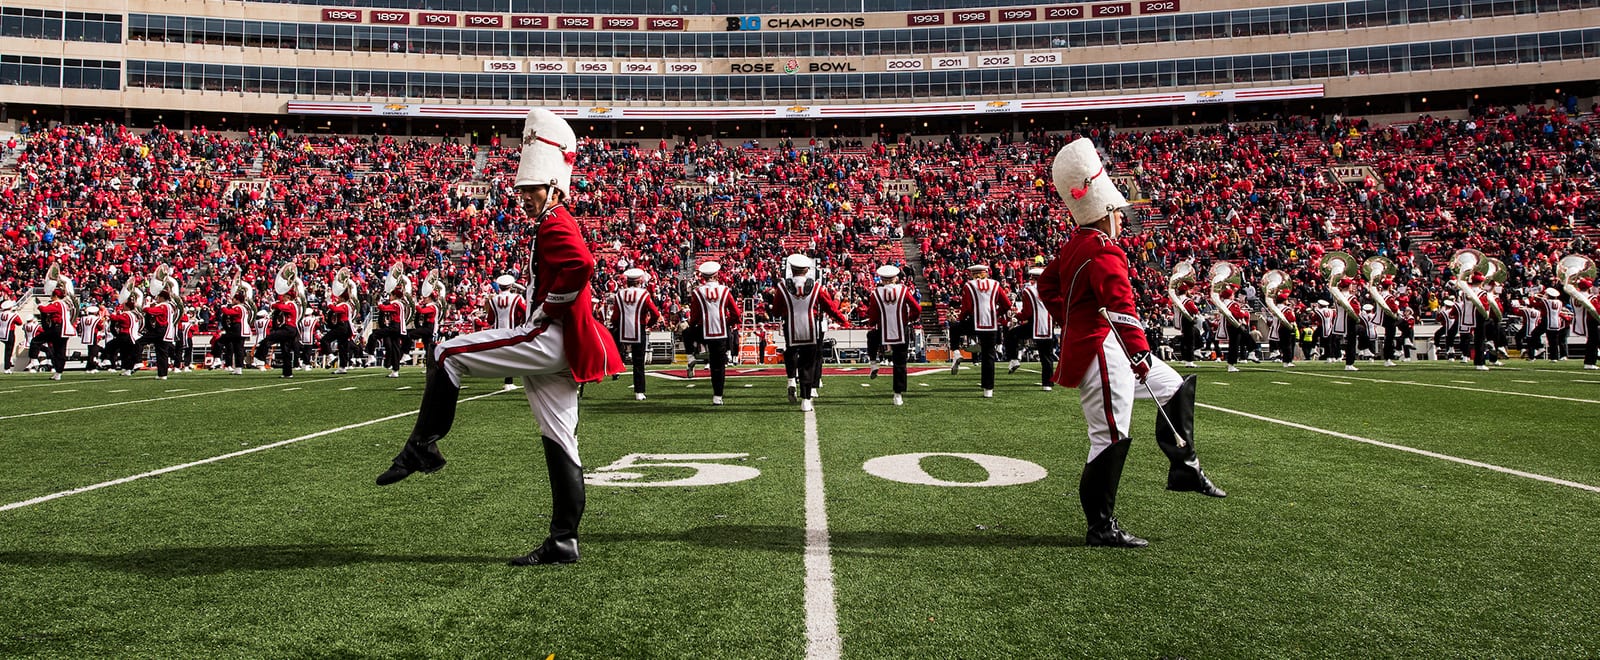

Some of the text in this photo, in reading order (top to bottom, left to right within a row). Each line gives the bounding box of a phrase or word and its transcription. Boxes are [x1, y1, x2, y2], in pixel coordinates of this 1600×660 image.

[1099, 5, 1125, 14] 2011
[1146, 2, 1174, 11] 2012
[327, 10, 358, 20] 1896
[376, 12, 405, 21] 1897
[957, 12, 986, 21] 1998
[1003, 10, 1032, 19] 1999
[1050, 8, 1079, 17] 2010
[425, 14, 451, 23] 1901
[470, 16, 499, 25] 1906
[519, 17, 542, 26] 1912
[563, 18, 589, 26] 1952
[607, 18, 634, 27] 1959
[767, 16, 865, 28] CHAMPIONS
[912, 14, 940, 23] 1993
[652, 19, 679, 28] 1962
[938, 59, 962, 68] 2011
[983, 56, 1010, 65] 2012
[1029, 54, 1057, 64] 2013
[490, 62, 516, 71] 1953
[535, 63, 563, 72] 1960
[581, 63, 607, 72] 1963
[626, 63, 652, 72] 1994
[670, 64, 697, 72] 1999
[730, 62, 857, 73] ROSE BOWL
[888, 60, 921, 69] 2000
[976, 279, 990, 293] W
[624, 290, 637, 305] W
[706, 287, 719, 303] W
[884, 287, 897, 305] W
[497, 295, 508, 309] W
